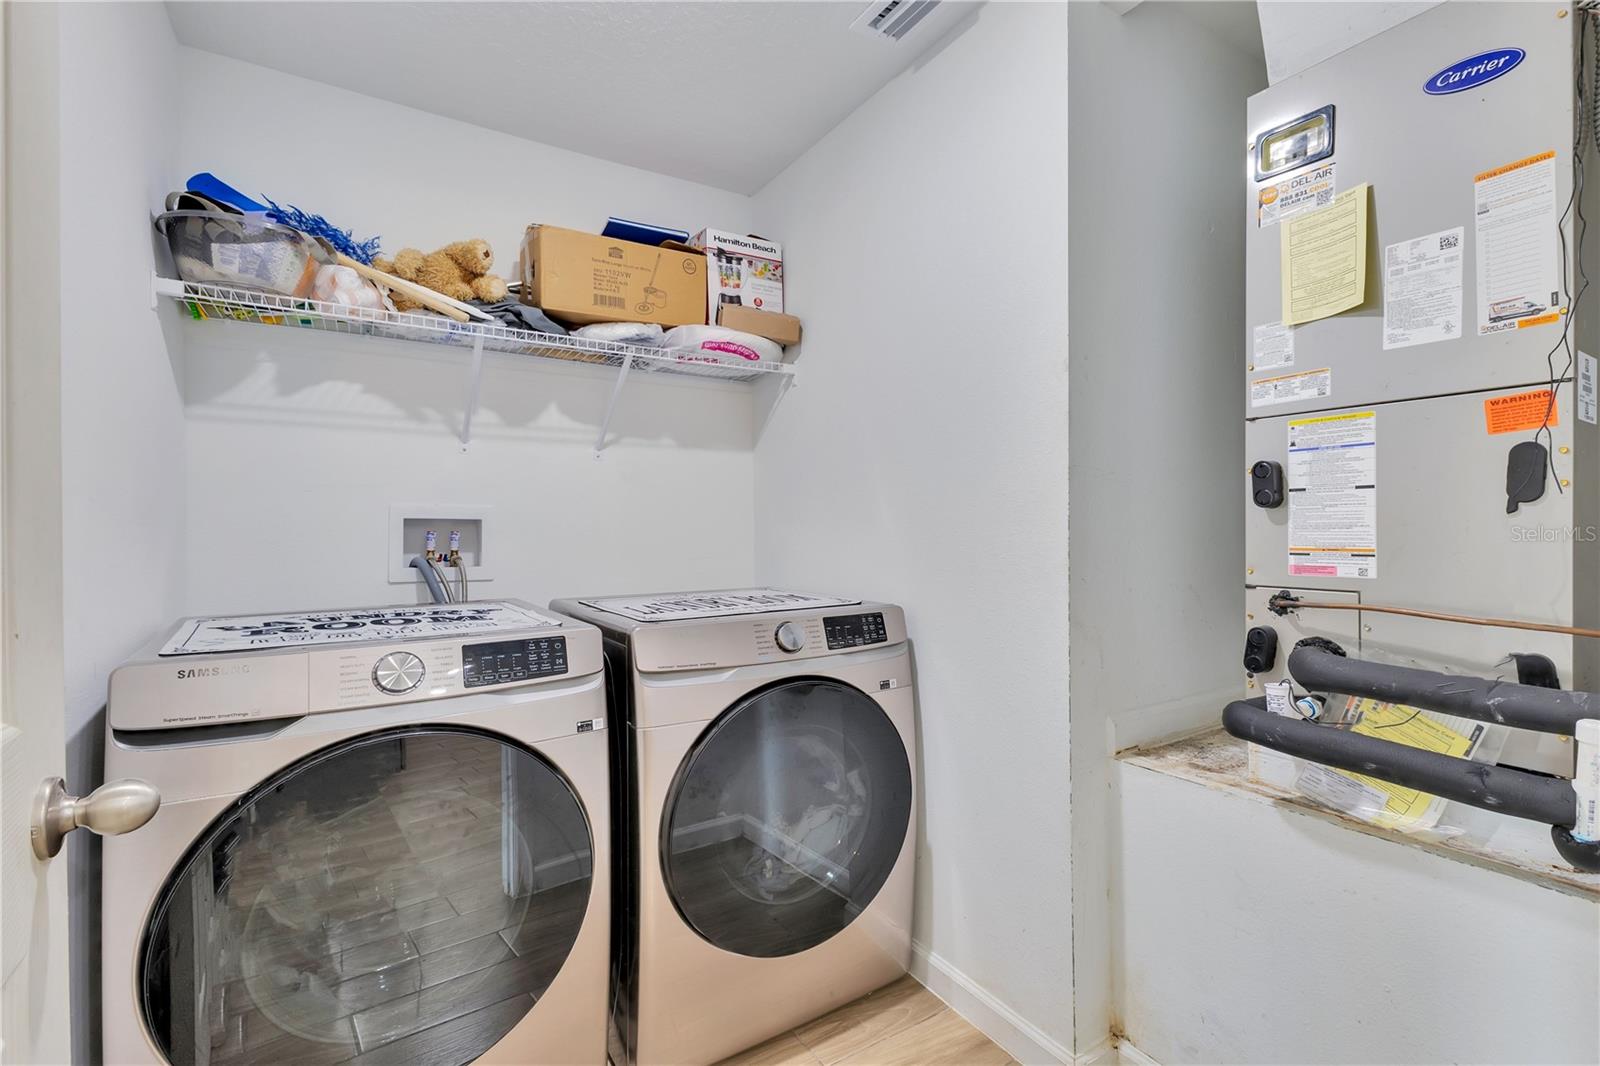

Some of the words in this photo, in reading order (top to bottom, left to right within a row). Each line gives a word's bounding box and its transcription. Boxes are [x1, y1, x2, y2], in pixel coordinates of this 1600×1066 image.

[1436, 55, 1510, 87] Carrier
[713, 235, 751, 249] Hamilton
[752, 243, 777, 254] Beach
[1490, 391, 1552, 406] WARNING
[206, 608, 503, 632] LAUNDRY
[241, 615, 494, 638] ROOM
